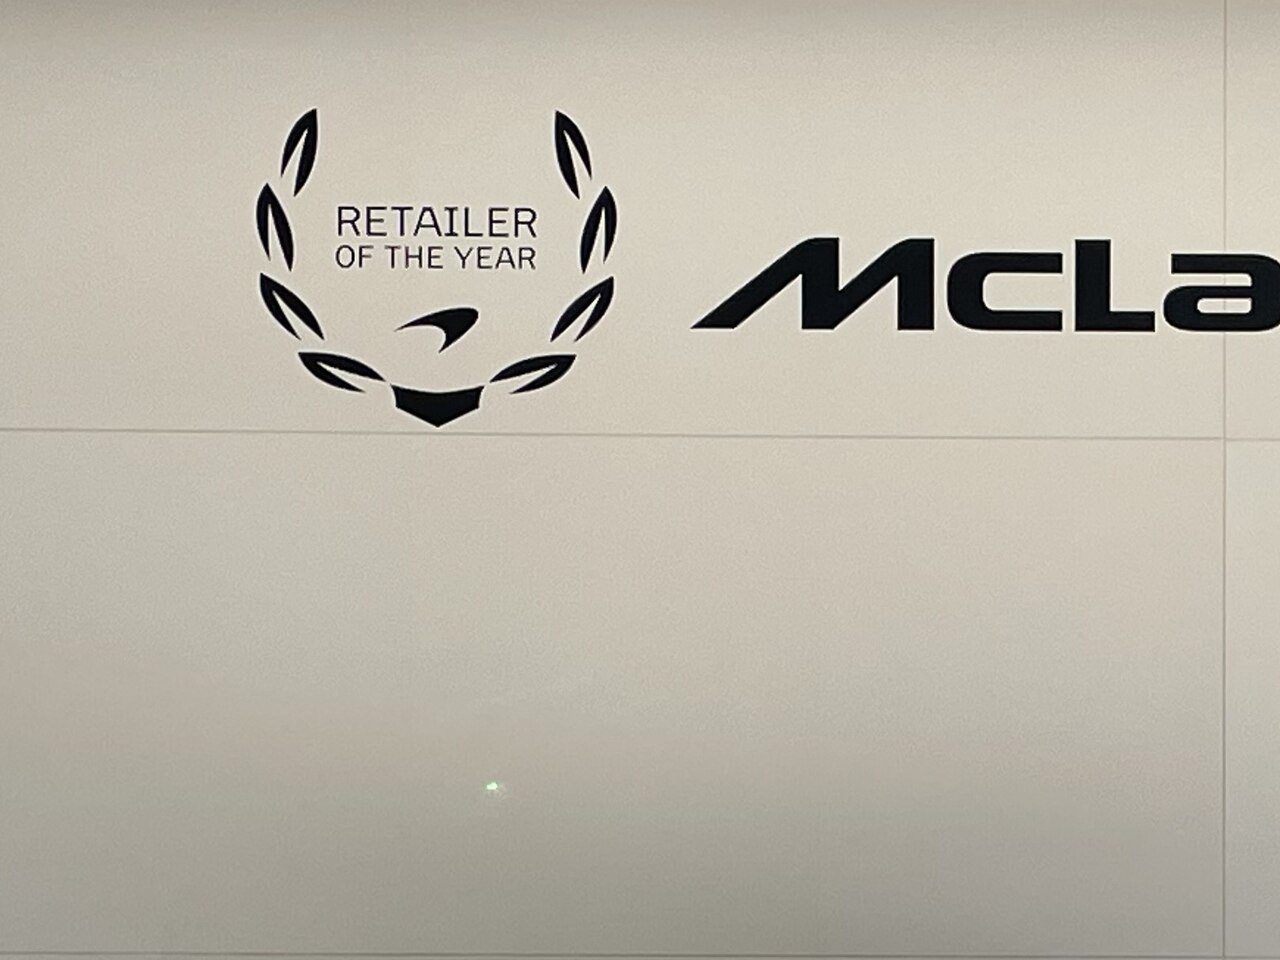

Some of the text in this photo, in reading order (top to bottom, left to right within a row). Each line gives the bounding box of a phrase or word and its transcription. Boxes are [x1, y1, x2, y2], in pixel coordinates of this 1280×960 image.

[336, 206, 537, 237] RETAILER
[335, 244, 536, 269] OF THE YEAR
